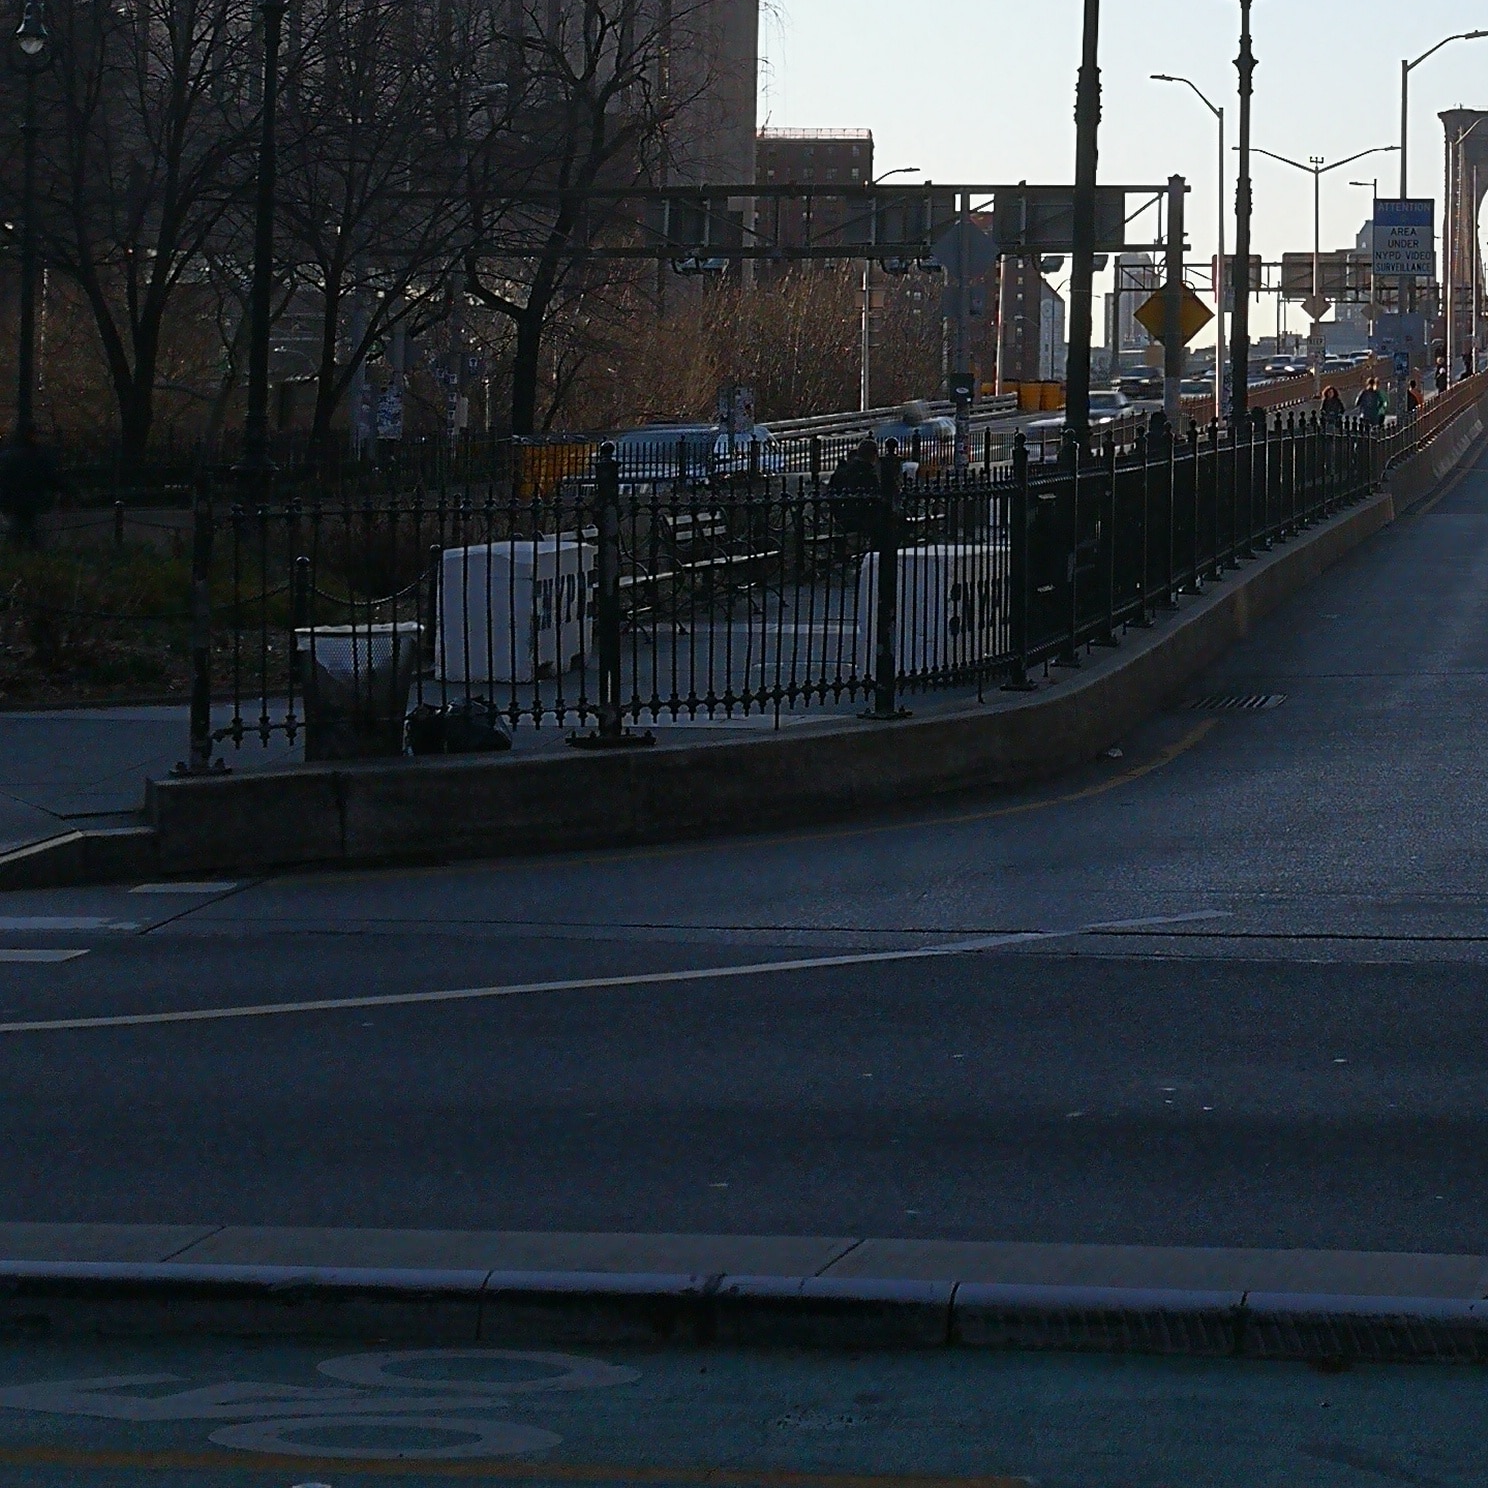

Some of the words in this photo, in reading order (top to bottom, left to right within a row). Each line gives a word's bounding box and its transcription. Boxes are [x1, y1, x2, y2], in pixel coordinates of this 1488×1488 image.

[1377, 202, 1430, 211] ATTENTION
[1390, 227, 1417, 236] AREA
[1388, 239, 1419, 248] UNDER
[1376, 251, 1401, 260] NYPD
[1405, 251, 1431, 260] VIDEO
[1376, 263, 1431, 272] SURVEILLANCE
